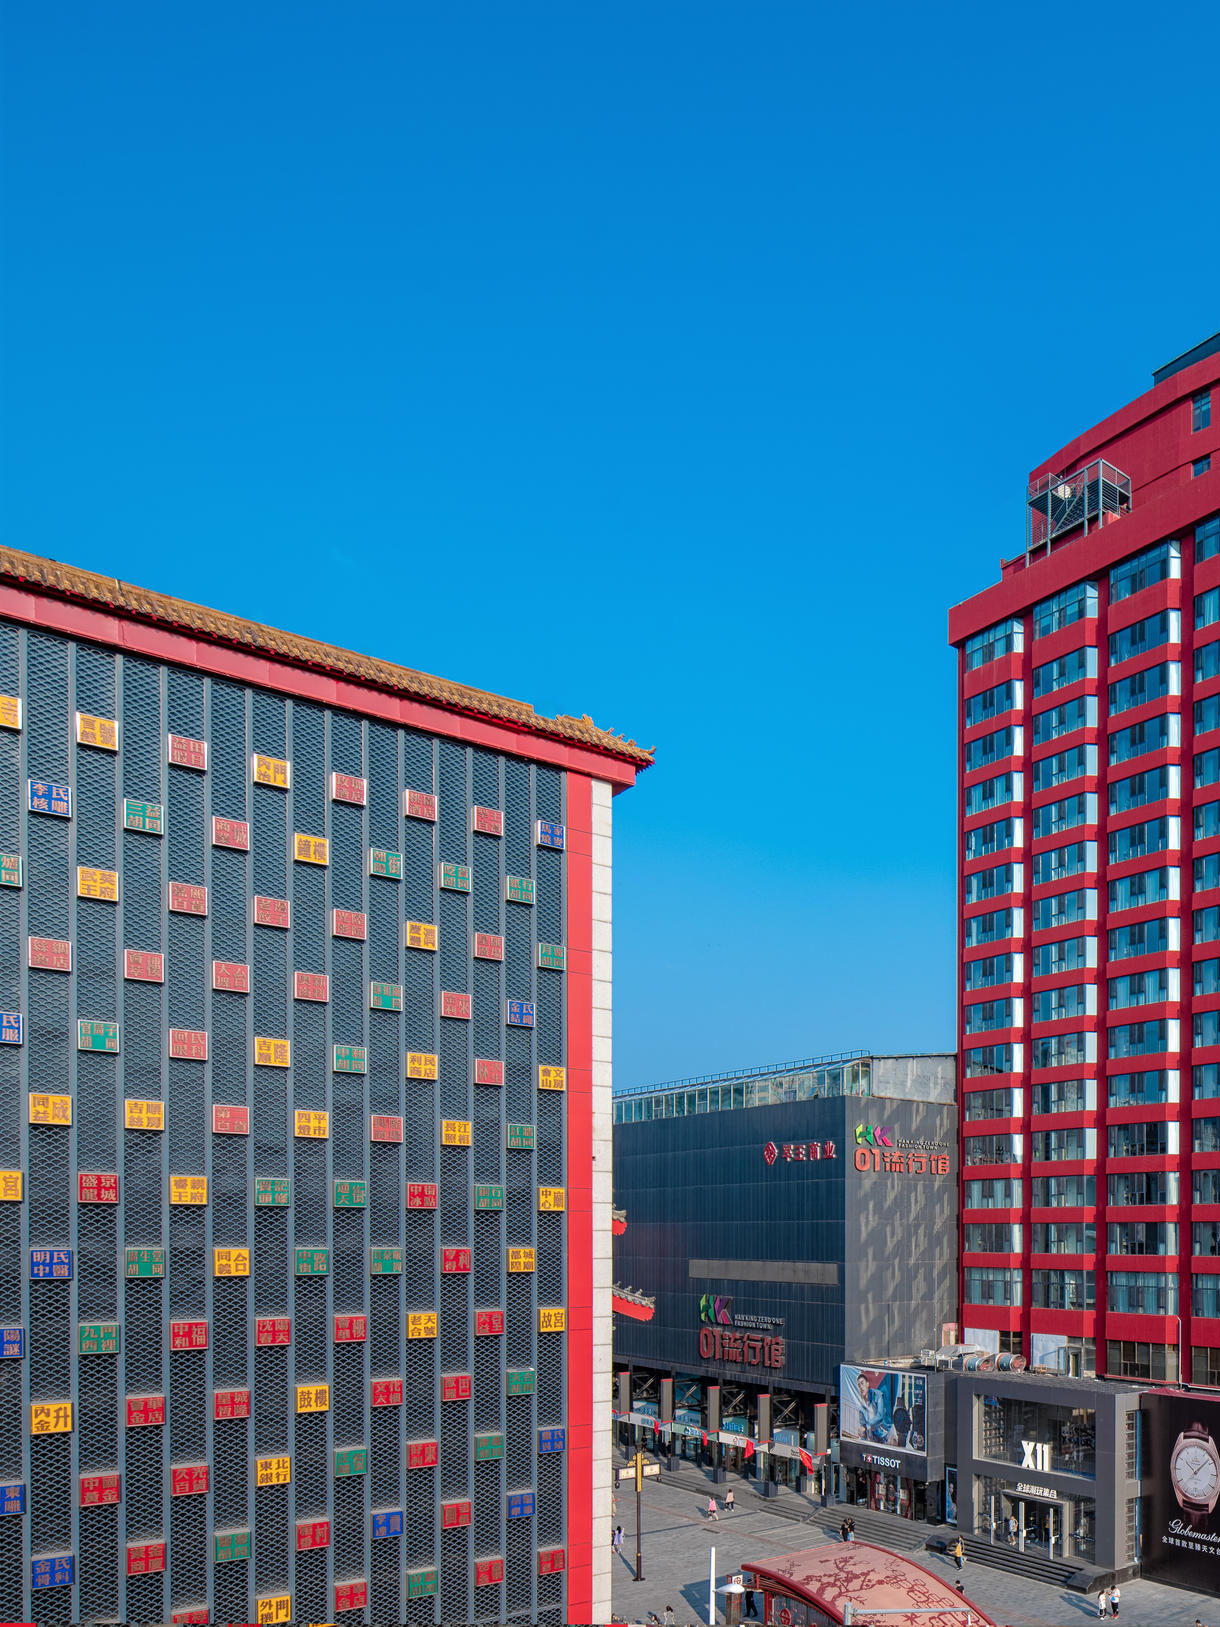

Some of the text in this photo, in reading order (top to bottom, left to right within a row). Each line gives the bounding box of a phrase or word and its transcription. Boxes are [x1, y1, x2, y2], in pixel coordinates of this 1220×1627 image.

[855, 1148, 950, 1175] 01流行馆
[542, 1312, 564, 1329] 故宮
[700, 1327, 785, 1368] 01流行馆
[299, 1390, 326, 1409] 鼓樓
[872, 1455, 901, 1469] TISSOT
